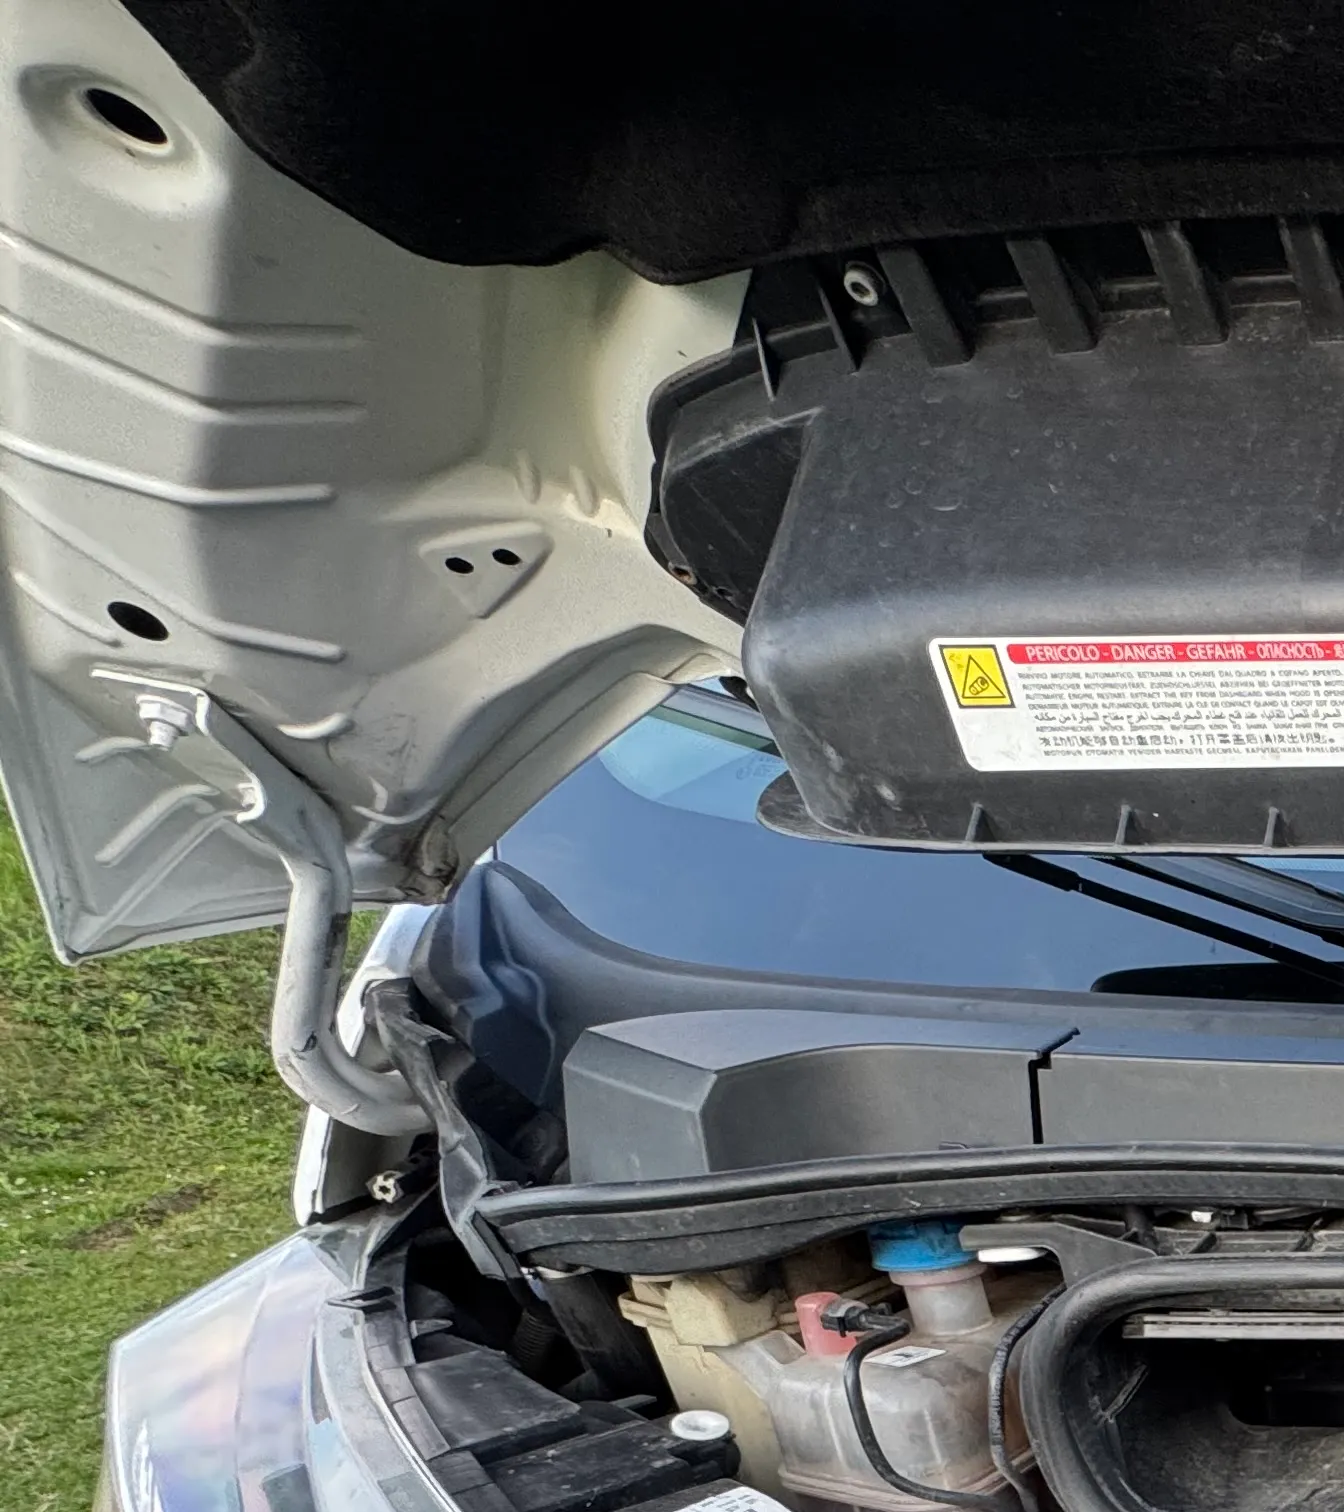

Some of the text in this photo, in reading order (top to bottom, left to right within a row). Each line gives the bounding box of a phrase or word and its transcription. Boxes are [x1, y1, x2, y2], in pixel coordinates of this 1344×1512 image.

[1027, 644, 1100, 661] PERICOLO
[1110, 643, 1176, 661] DANGER
[1187, 643, 1247, 660] GEFAHR
[1256, 643, 1324, 659] ОПАСНОСТЬ
